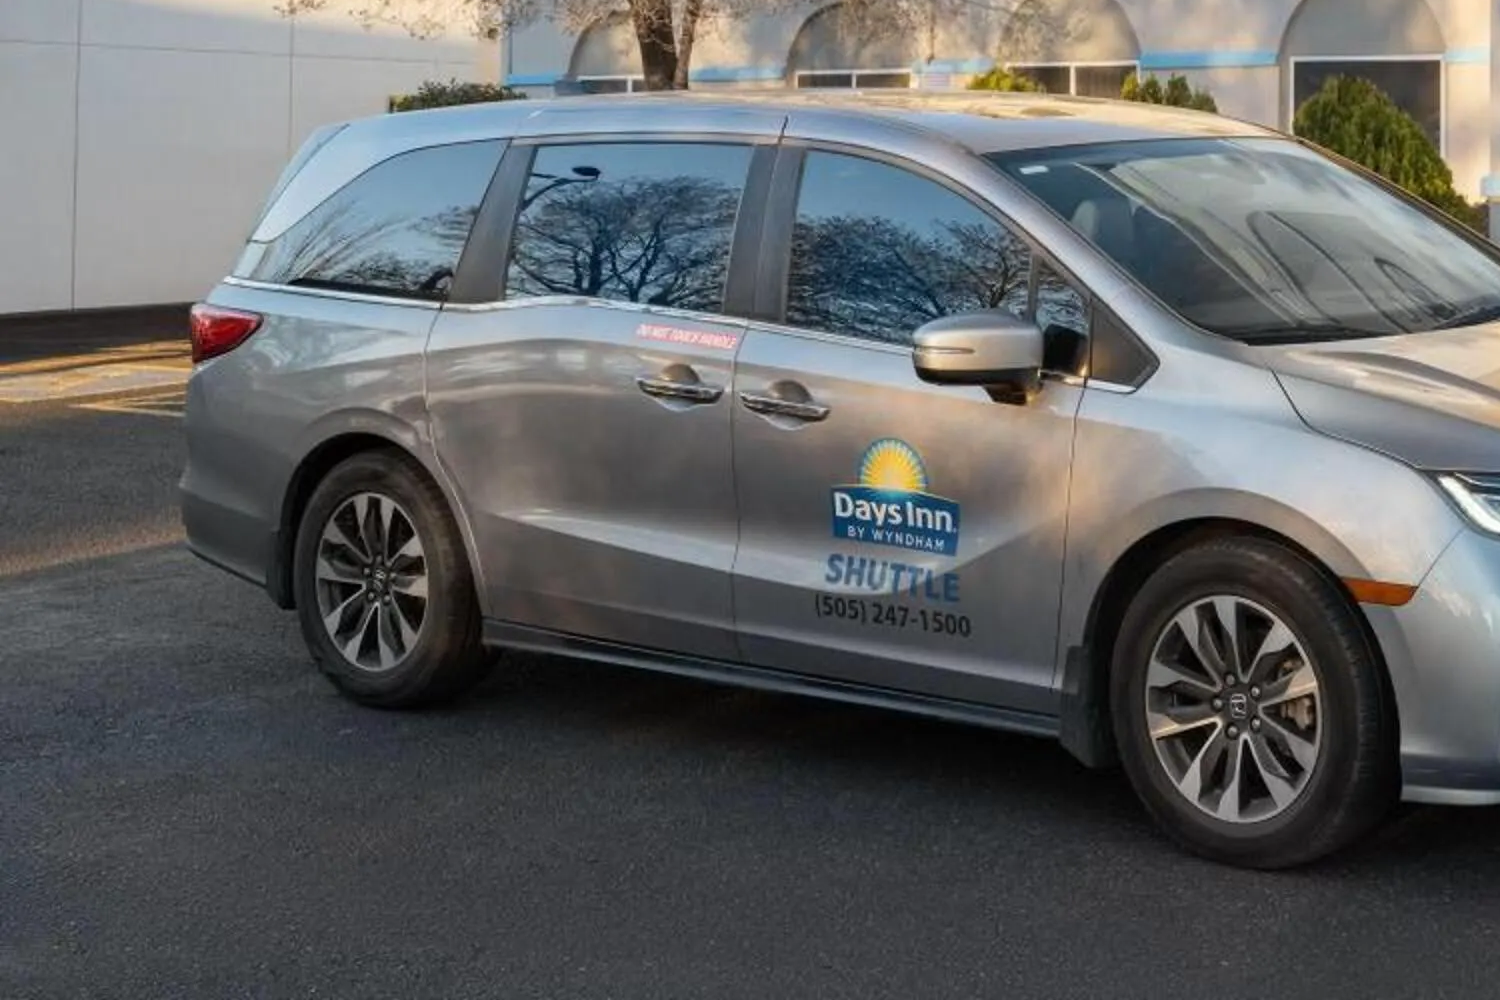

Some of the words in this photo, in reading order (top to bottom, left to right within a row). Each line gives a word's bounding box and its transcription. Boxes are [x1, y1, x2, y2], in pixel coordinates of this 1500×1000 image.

[834, 491, 901, 526] Days
[906, 502, 952, 532] Inn
[848, 525, 865, 538] BY
[873, 529, 945, 551] WYNDHAM
[825, 553, 960, 603] SHUTTLE
[815, 594, 867, 624] (505)
[872, 603, 972, 637] 247-1500
